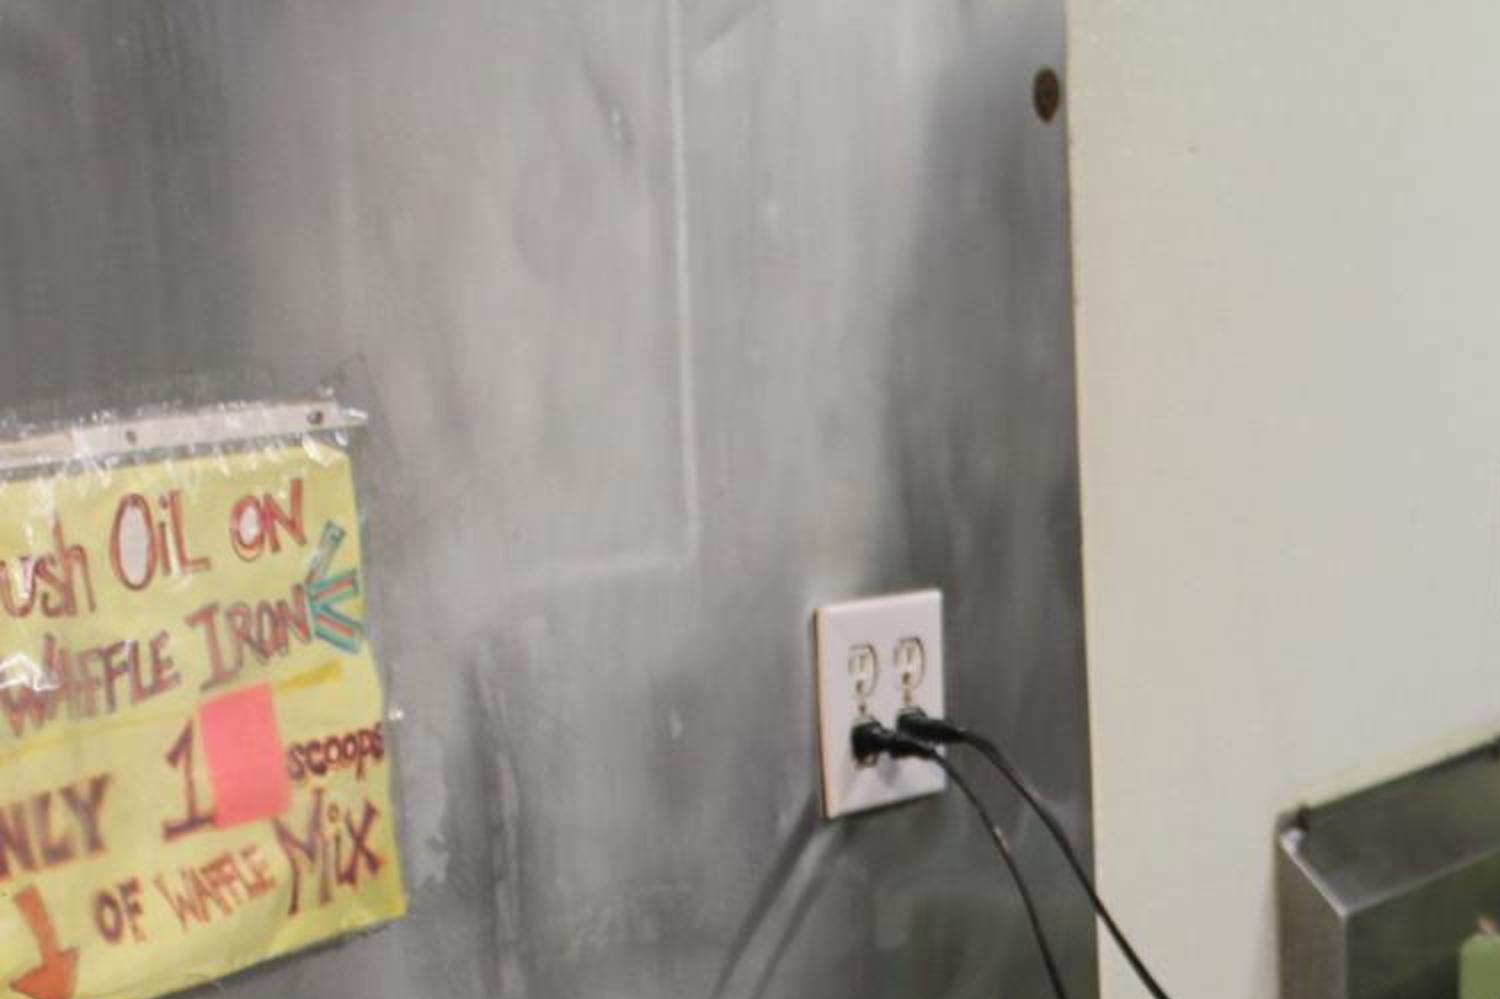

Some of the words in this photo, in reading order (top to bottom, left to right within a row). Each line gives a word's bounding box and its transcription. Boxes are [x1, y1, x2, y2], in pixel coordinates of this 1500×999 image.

[229, 478, 307, 562] ON
[184, 582, 312, 692] IRON
[161, 718, 216, 843] 1
[94, 873, 147, 943] OF
[154, 844, 276, 930] WAFFLE
